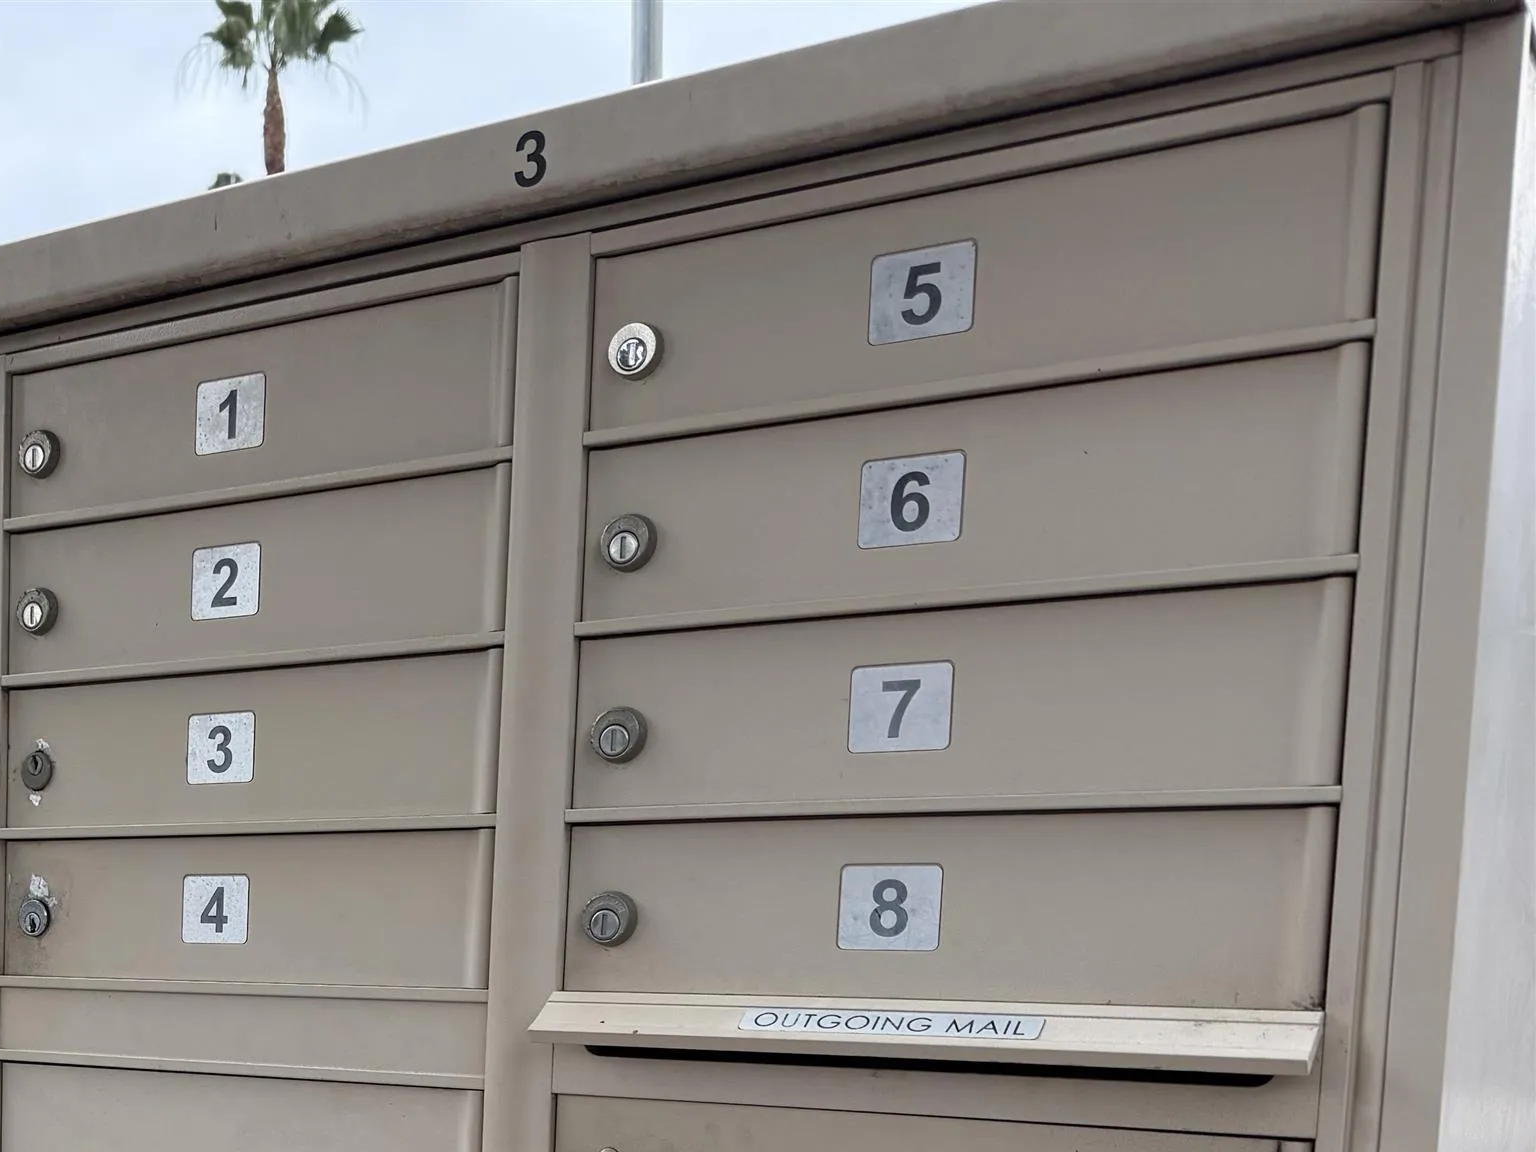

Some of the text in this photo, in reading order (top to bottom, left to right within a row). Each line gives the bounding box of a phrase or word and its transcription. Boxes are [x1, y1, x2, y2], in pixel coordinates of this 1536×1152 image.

[515, 131, 546, 187] 3
[901, 262, 941, 325] 5
[219, 389, 237, 439] 1
[891, 471, 930, 531] 6
[210, 558, 239, 608] 2
[882, 679, 921, 738] 7
[207, 725, 232, 774] 3
[201, 886, 228, 934] 4
[870, 879, 908, 937] 8
[754, 1012, 1026, 1036] OUTGOING MAIL
